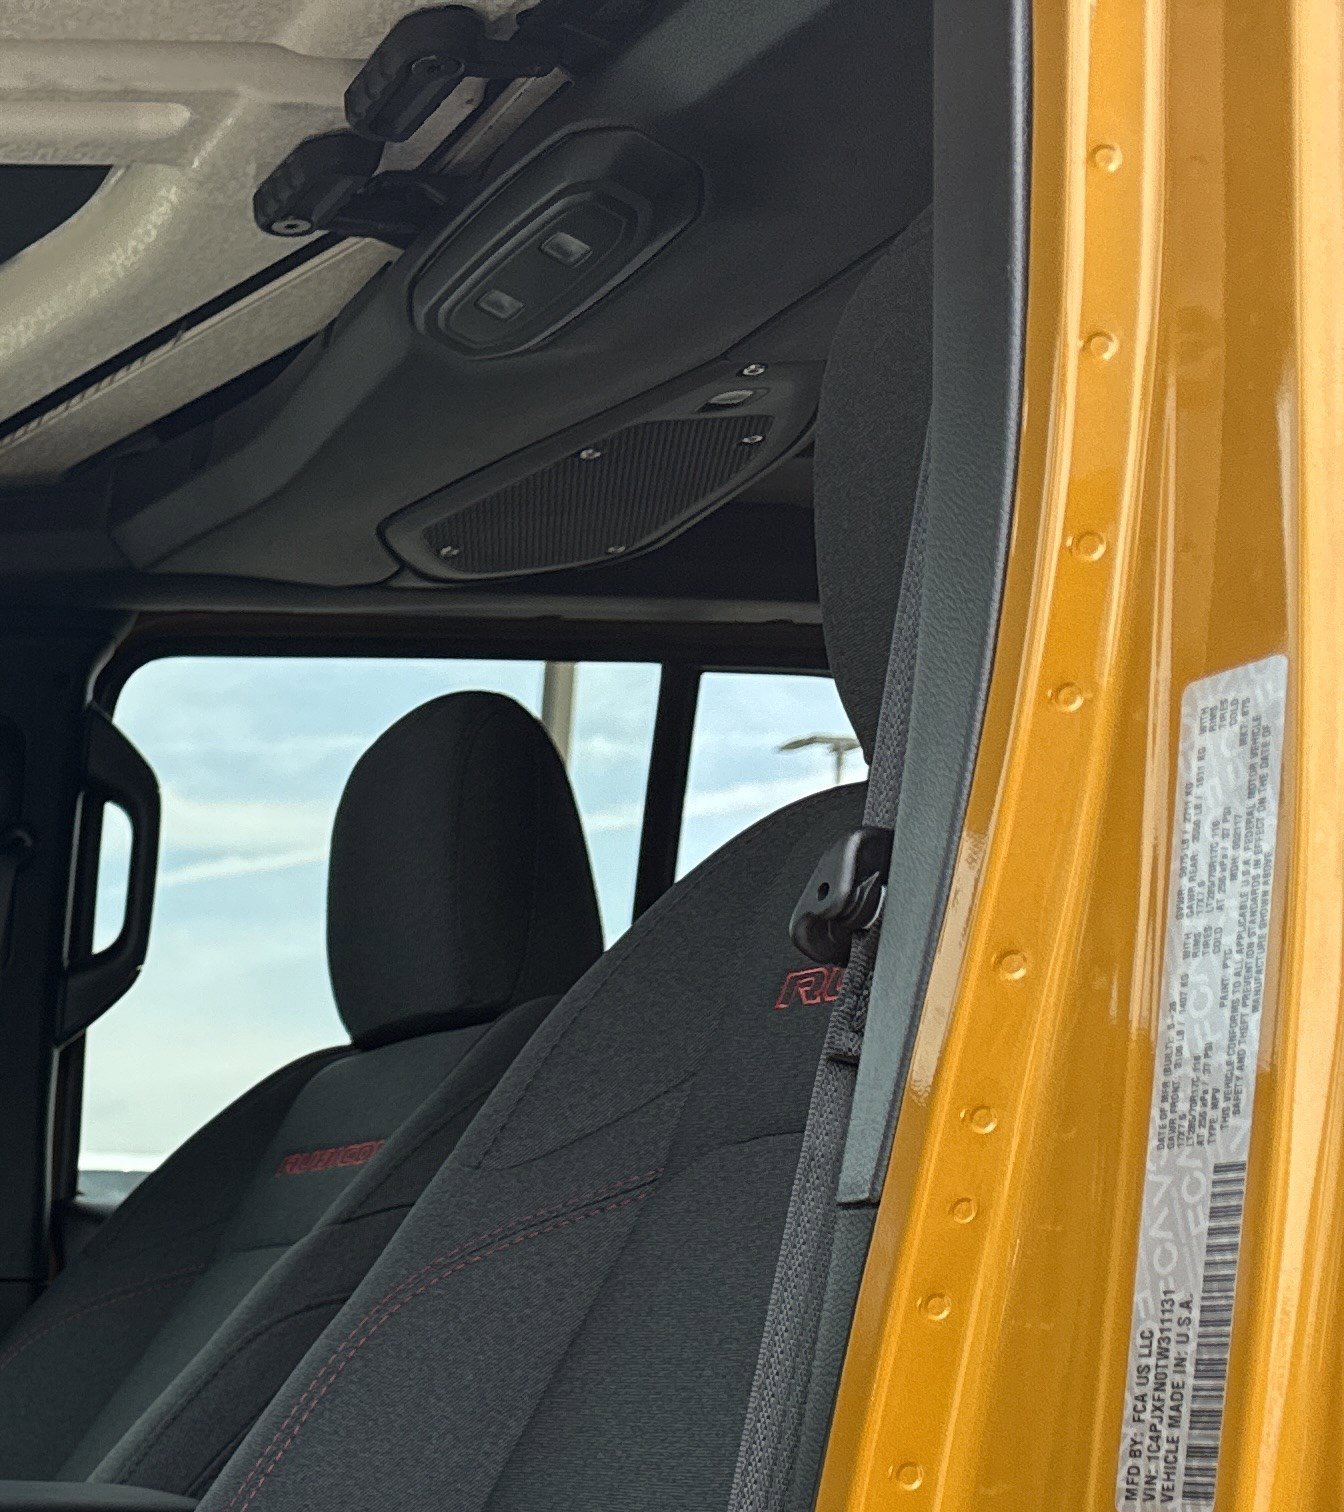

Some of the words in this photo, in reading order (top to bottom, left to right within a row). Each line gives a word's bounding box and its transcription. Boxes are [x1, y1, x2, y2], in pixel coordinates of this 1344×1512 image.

[1229, 698, 1238, 726] COLD
[1249, 714, 1261, 759] VEHICLE
[1259, 740, 1270, 769] DATE
[1246, 761, 1258, 800] MOTOR
[1258, 772, 1268, 794] THE
[1257, 796, 1266, 812] ON
[1243, 803, 1255, 851] FEDERAL
[1253, 816, 1265, 855] EFFECT
[1253, 857, 1261, 869] IN
[1247, 873, 1261, 938] STANDARDS
[1235, 891, 1249, 954] APPLICABLE
[1192, 931, 1201, 958] RIMS
[1202, 925, 1212, 956] TIRES
[1212, 926, 1223, 954] COLD
[1233, 959, 1243, 978] ALL
[1241, 941, 1255, 1007] PREVENTION
[1232, 980, 1241, 994] TO
[1167, 1117, 1176, 1149] GAWR
[1182, 932, 1191, 960] WITH
[1226, 997, 1240, 1056] CONFORMS
[1238, 1011, 1249, 1044] THEFT
[1236, 1048, 1246, 1070] AND
[1222, 1059, 1234, 1102] VEHICLE
[1232, 1074, 1243, 1114] SAFETY
[1159, 1106, 1168, 1120] OF
[1220, 1106, 1230, 1129] THIS
[1157, 1123, 1166, 1150] DATE
[1175, 1293, 1193, 1344] U.S.A.
[1138, 1329, 1153, 1357] LLC
[1136, 1364, 1150, 1385] US
[1173, 1350, 1188, 1373] IN:
[1132, 1393, 1147, 1422] FCA
[1167, 1380, 1184, 1427] MADE
[1129, 1432, 1143, 1457] BY:
[1125, 1465, 1140, 1500] MFD
[1160, 1435, 1179, 1502] VEHICLE
[1143, 1469, 1158, 1501] VIN:
